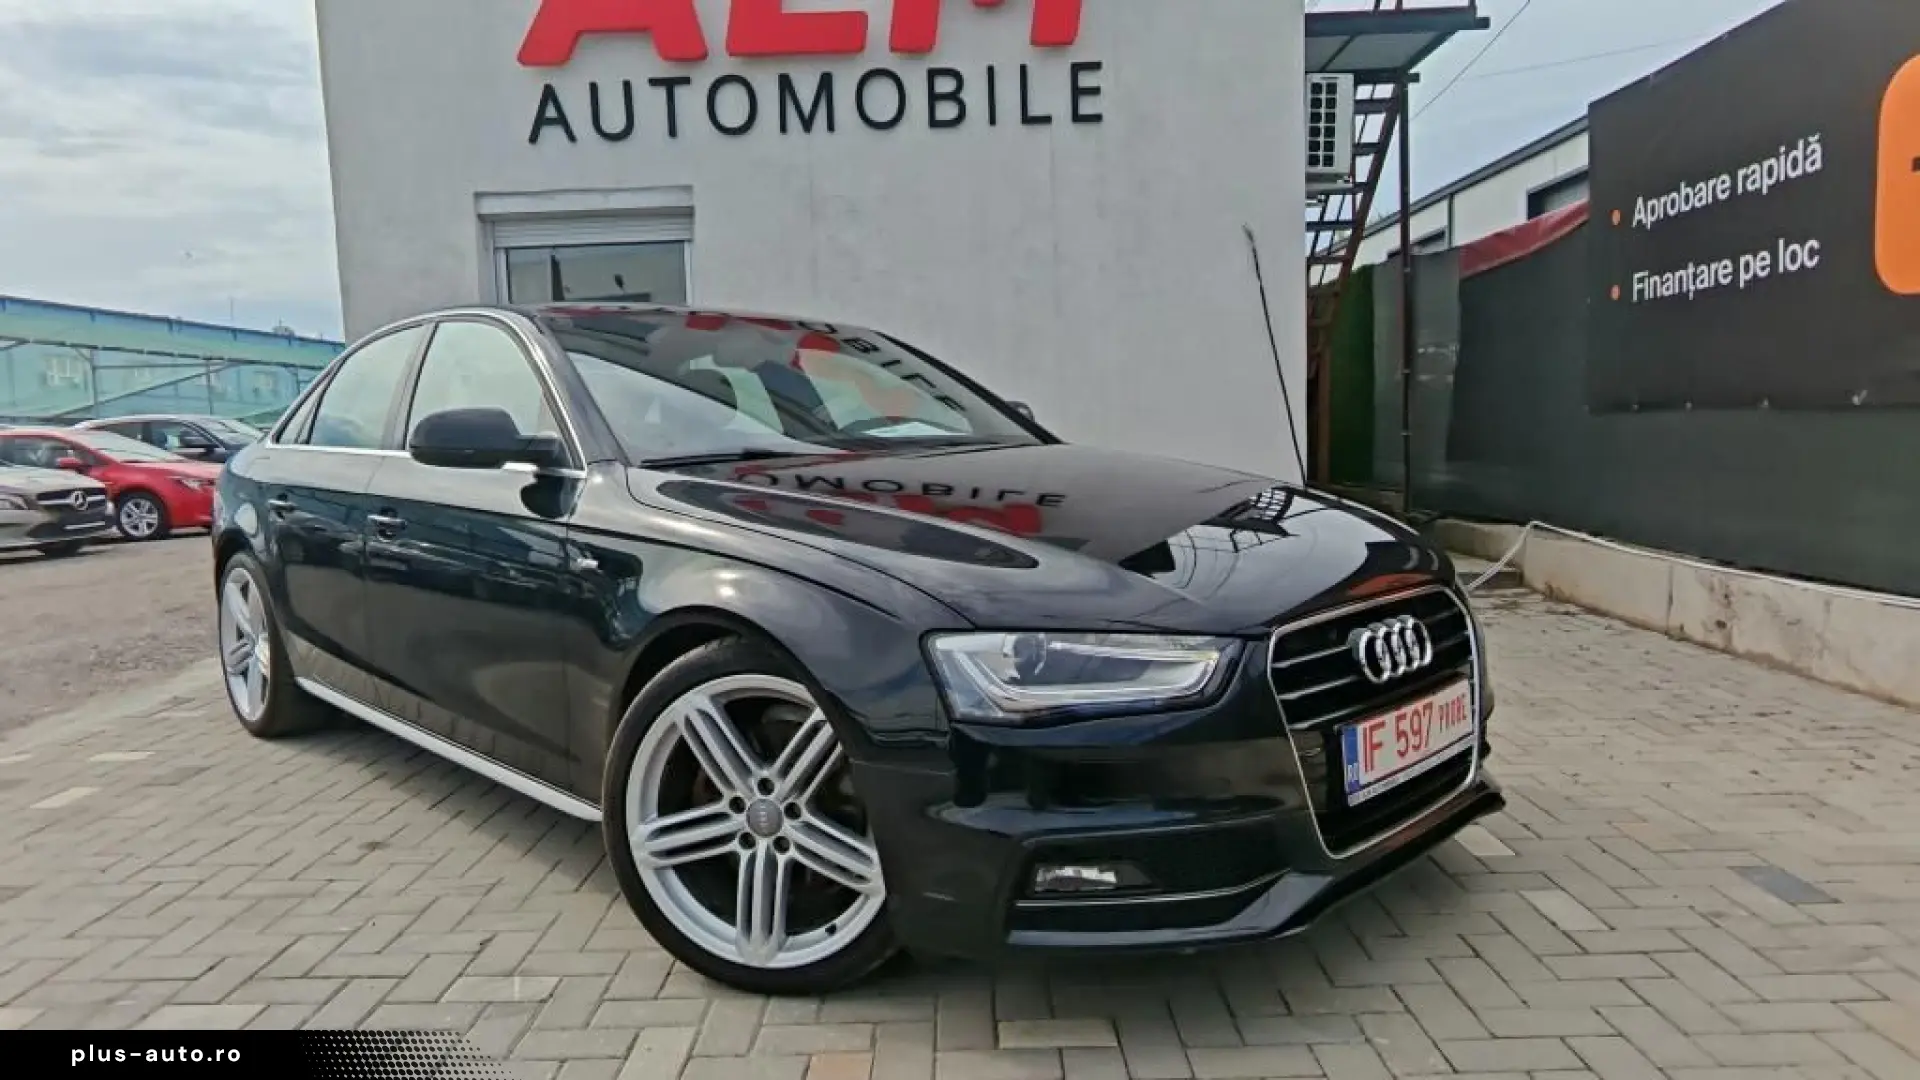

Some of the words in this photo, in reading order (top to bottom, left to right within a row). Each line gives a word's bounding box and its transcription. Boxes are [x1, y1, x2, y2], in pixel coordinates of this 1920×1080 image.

[528, 61, 1103, 144] AUTOMOBILE
[1631, 174, 1732, 230] Aprobare
[1737, 132, 1823, 196] rapidă
[1739, 249, 1772, 290] pe
[1777, 237, 1821, 274] loc
[1362, 721, 1386, 773] IF
[1394, 702, 1434, 758] 597
